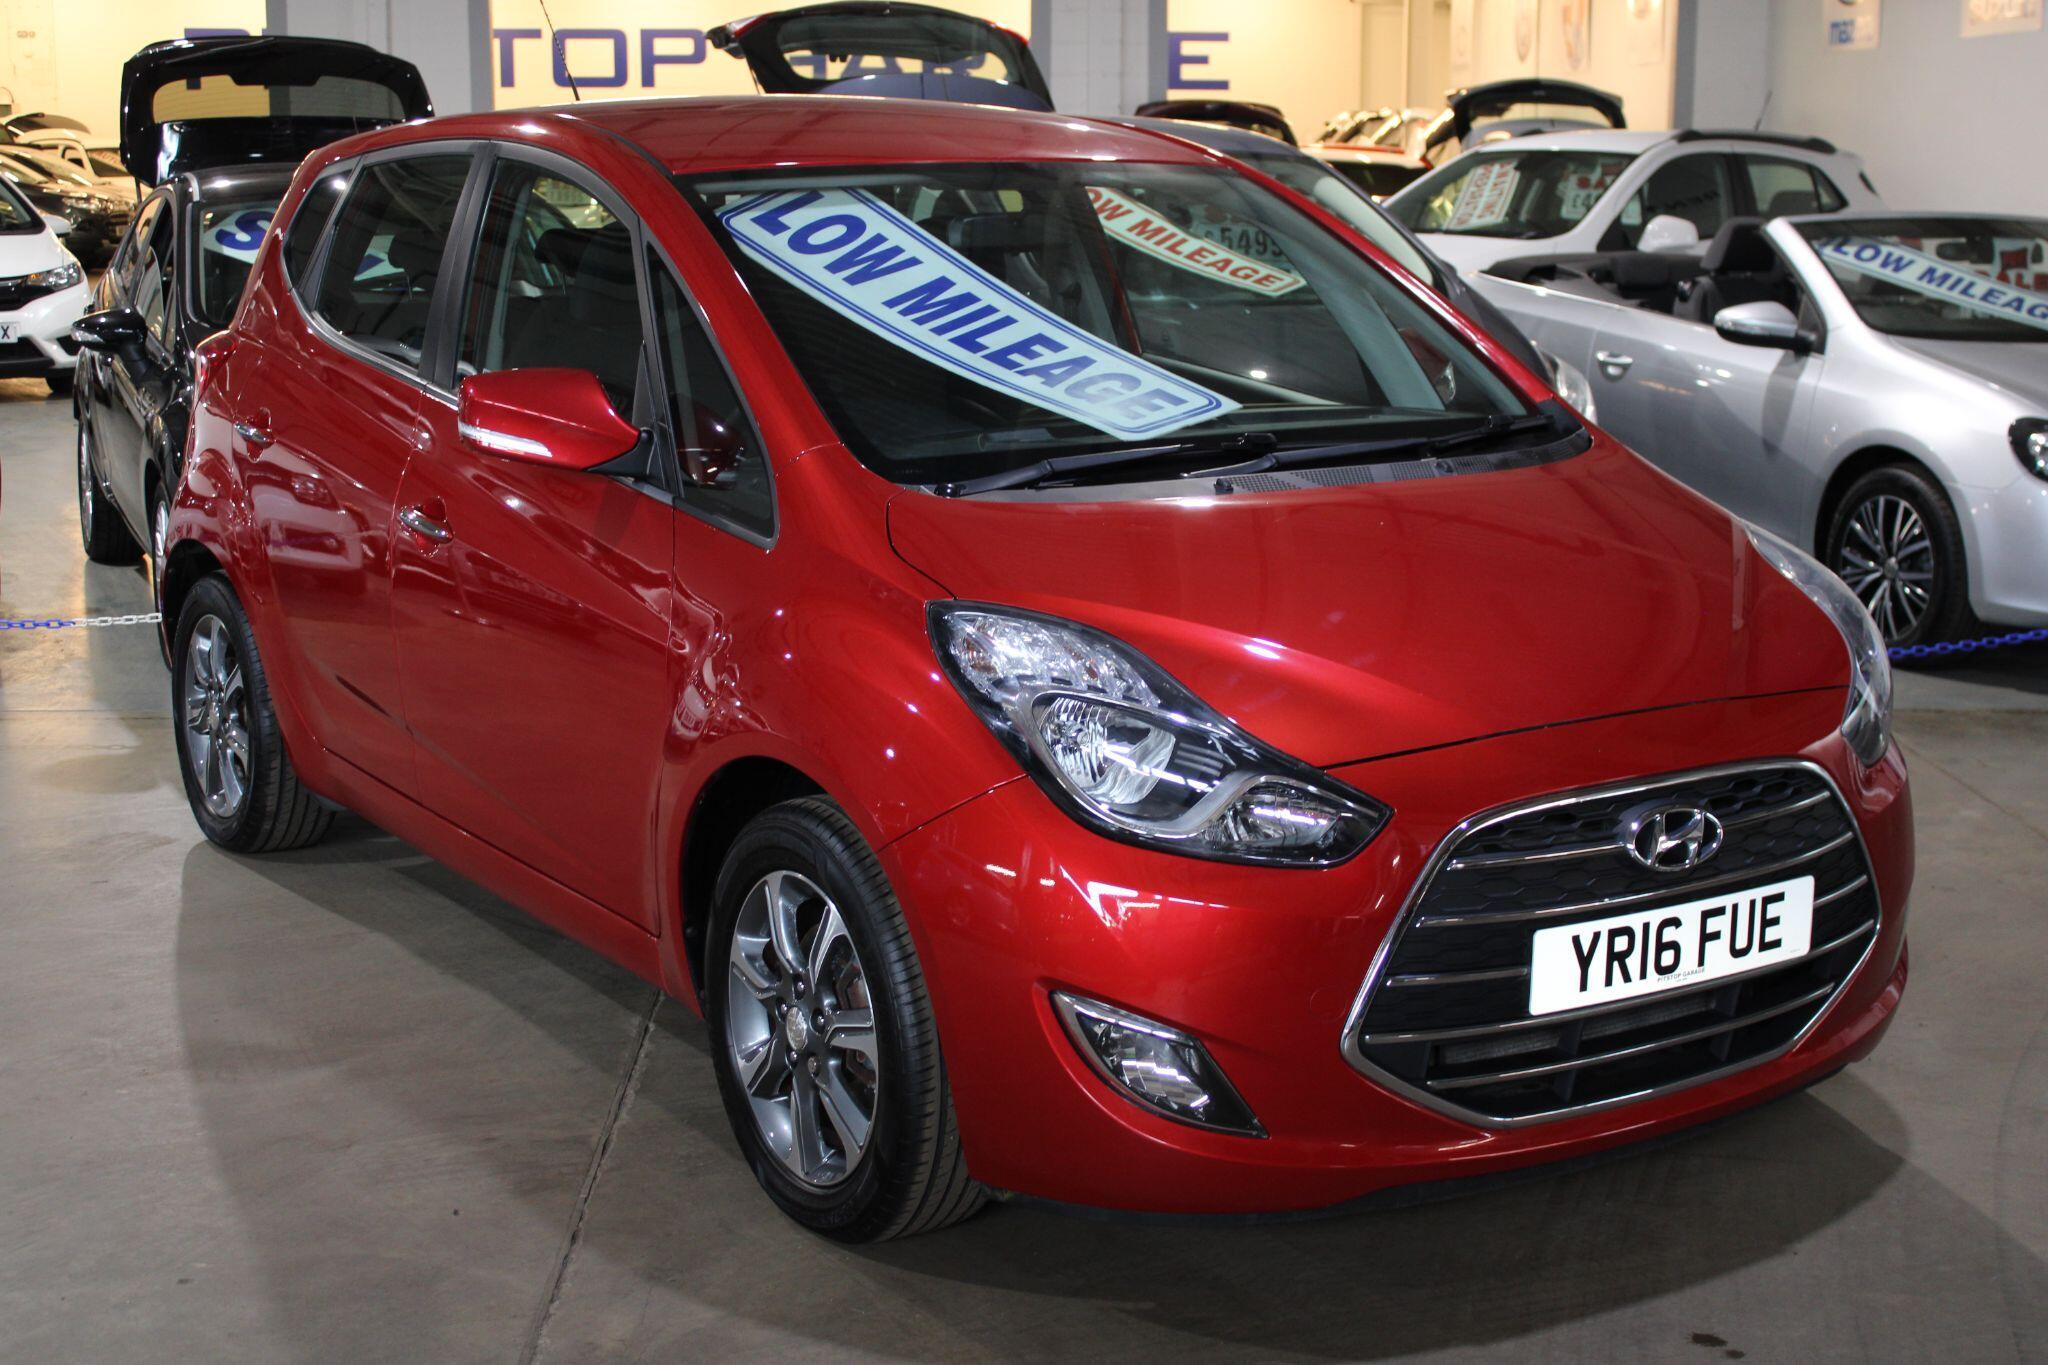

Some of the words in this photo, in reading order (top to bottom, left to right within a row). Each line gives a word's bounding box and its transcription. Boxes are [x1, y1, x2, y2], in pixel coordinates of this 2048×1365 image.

[1086, 188, 1133, 222] OW
[1126, 217, 1284, 288] MILEAGE
[1833, 236, 1914, 274] LOW
[1918, 264, 2048, 320] MILEAG
[750, 189, 924, 287] LOW
[881, 275, 1189, 420] MILEAGE
[1571, 916, 1683, 993] YR16
[1697, 891, 1785, 968] FUE
